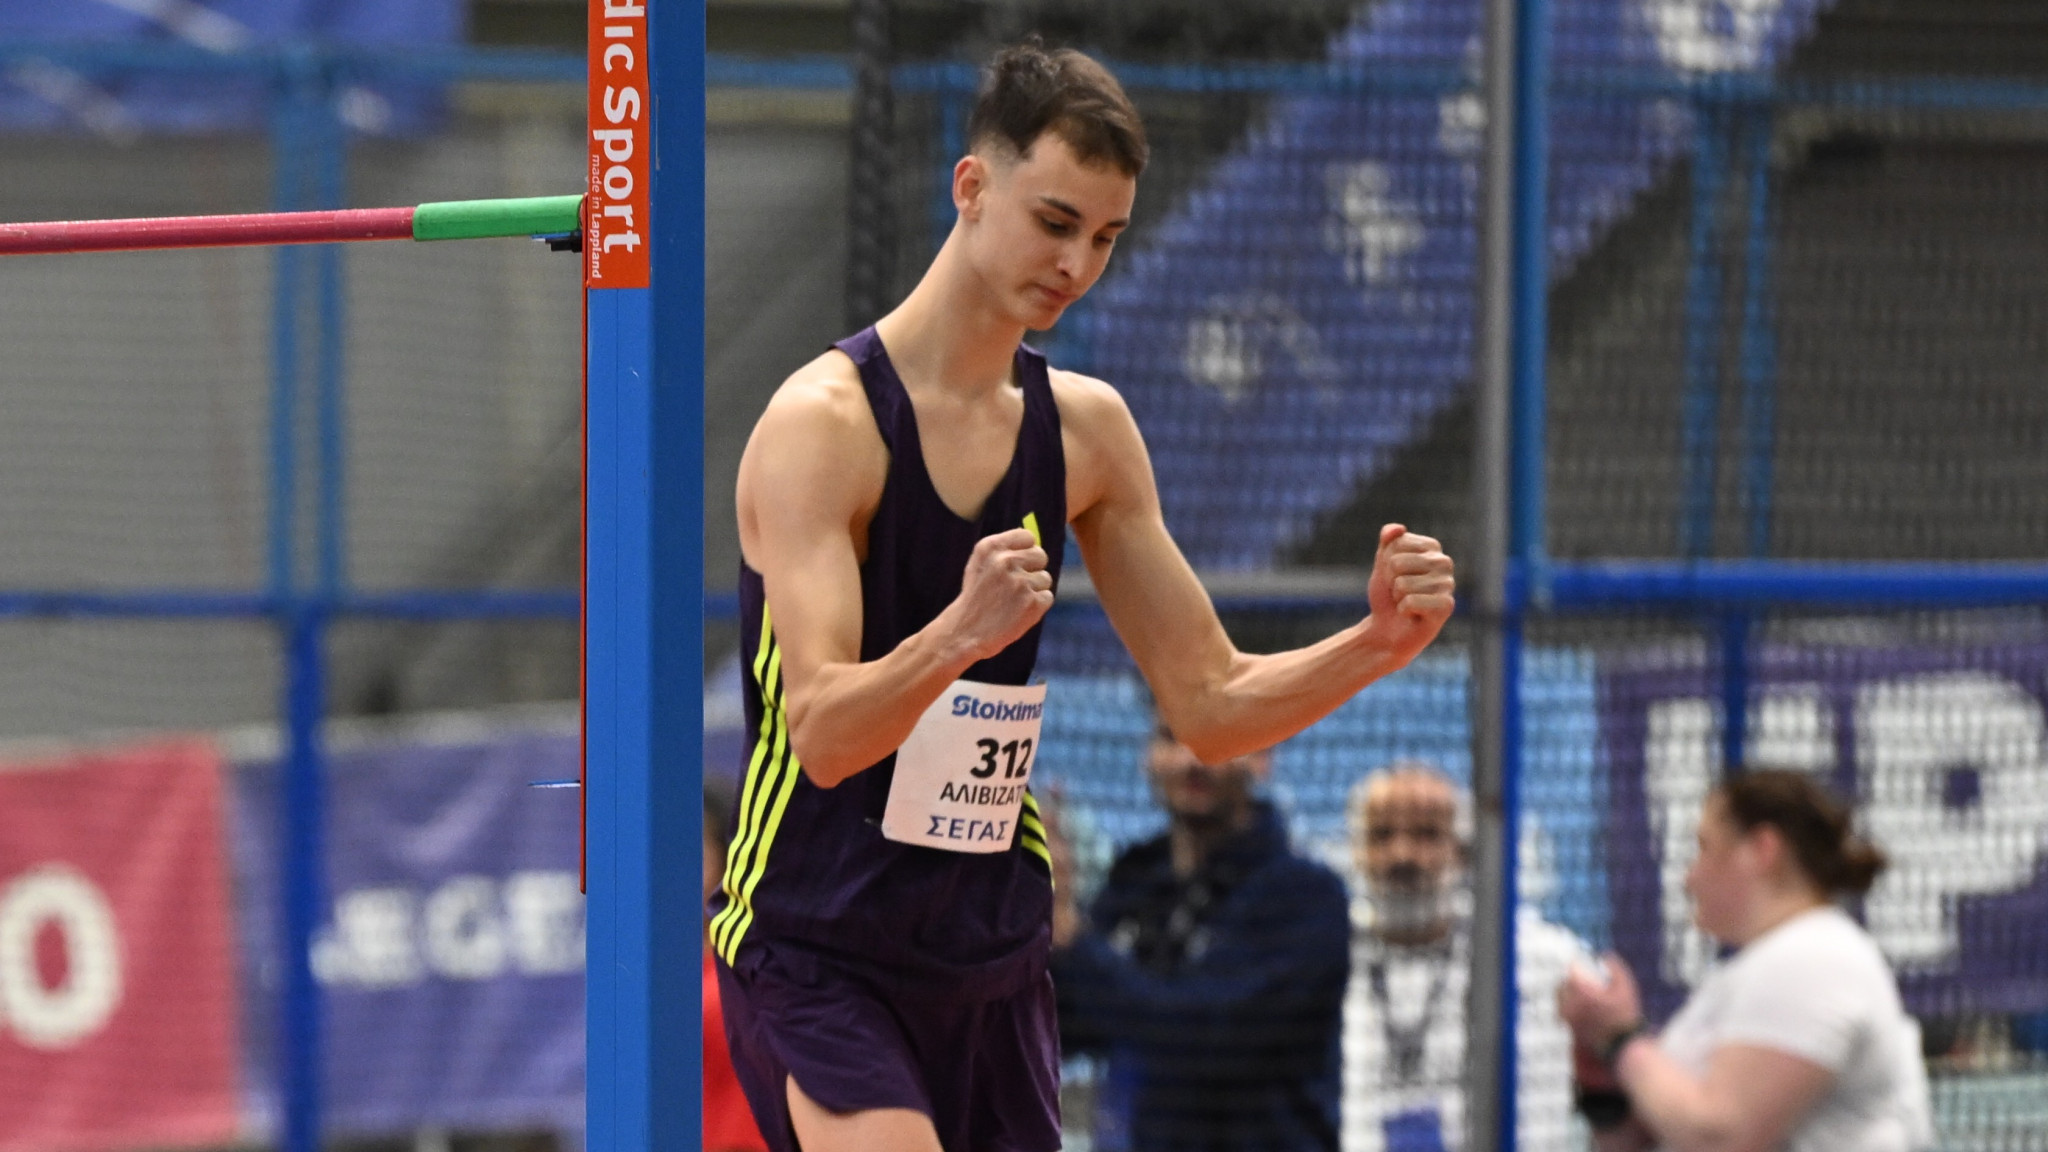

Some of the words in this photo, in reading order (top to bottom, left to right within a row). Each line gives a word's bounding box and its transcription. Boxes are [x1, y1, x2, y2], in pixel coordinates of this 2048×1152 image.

[592, 85, 641, 253] Sport
[592, 154, 602, 193] made
[592, 198, 602, 210] in
[589, 213, 602, 278] Lappland
[970, 738, 1032, 779] 312
[939, 781, 1027, 806] ΑΛΙΒΙΖΑΤ
[926, 815, 1009, 841] ΣΕΓΑΣ
